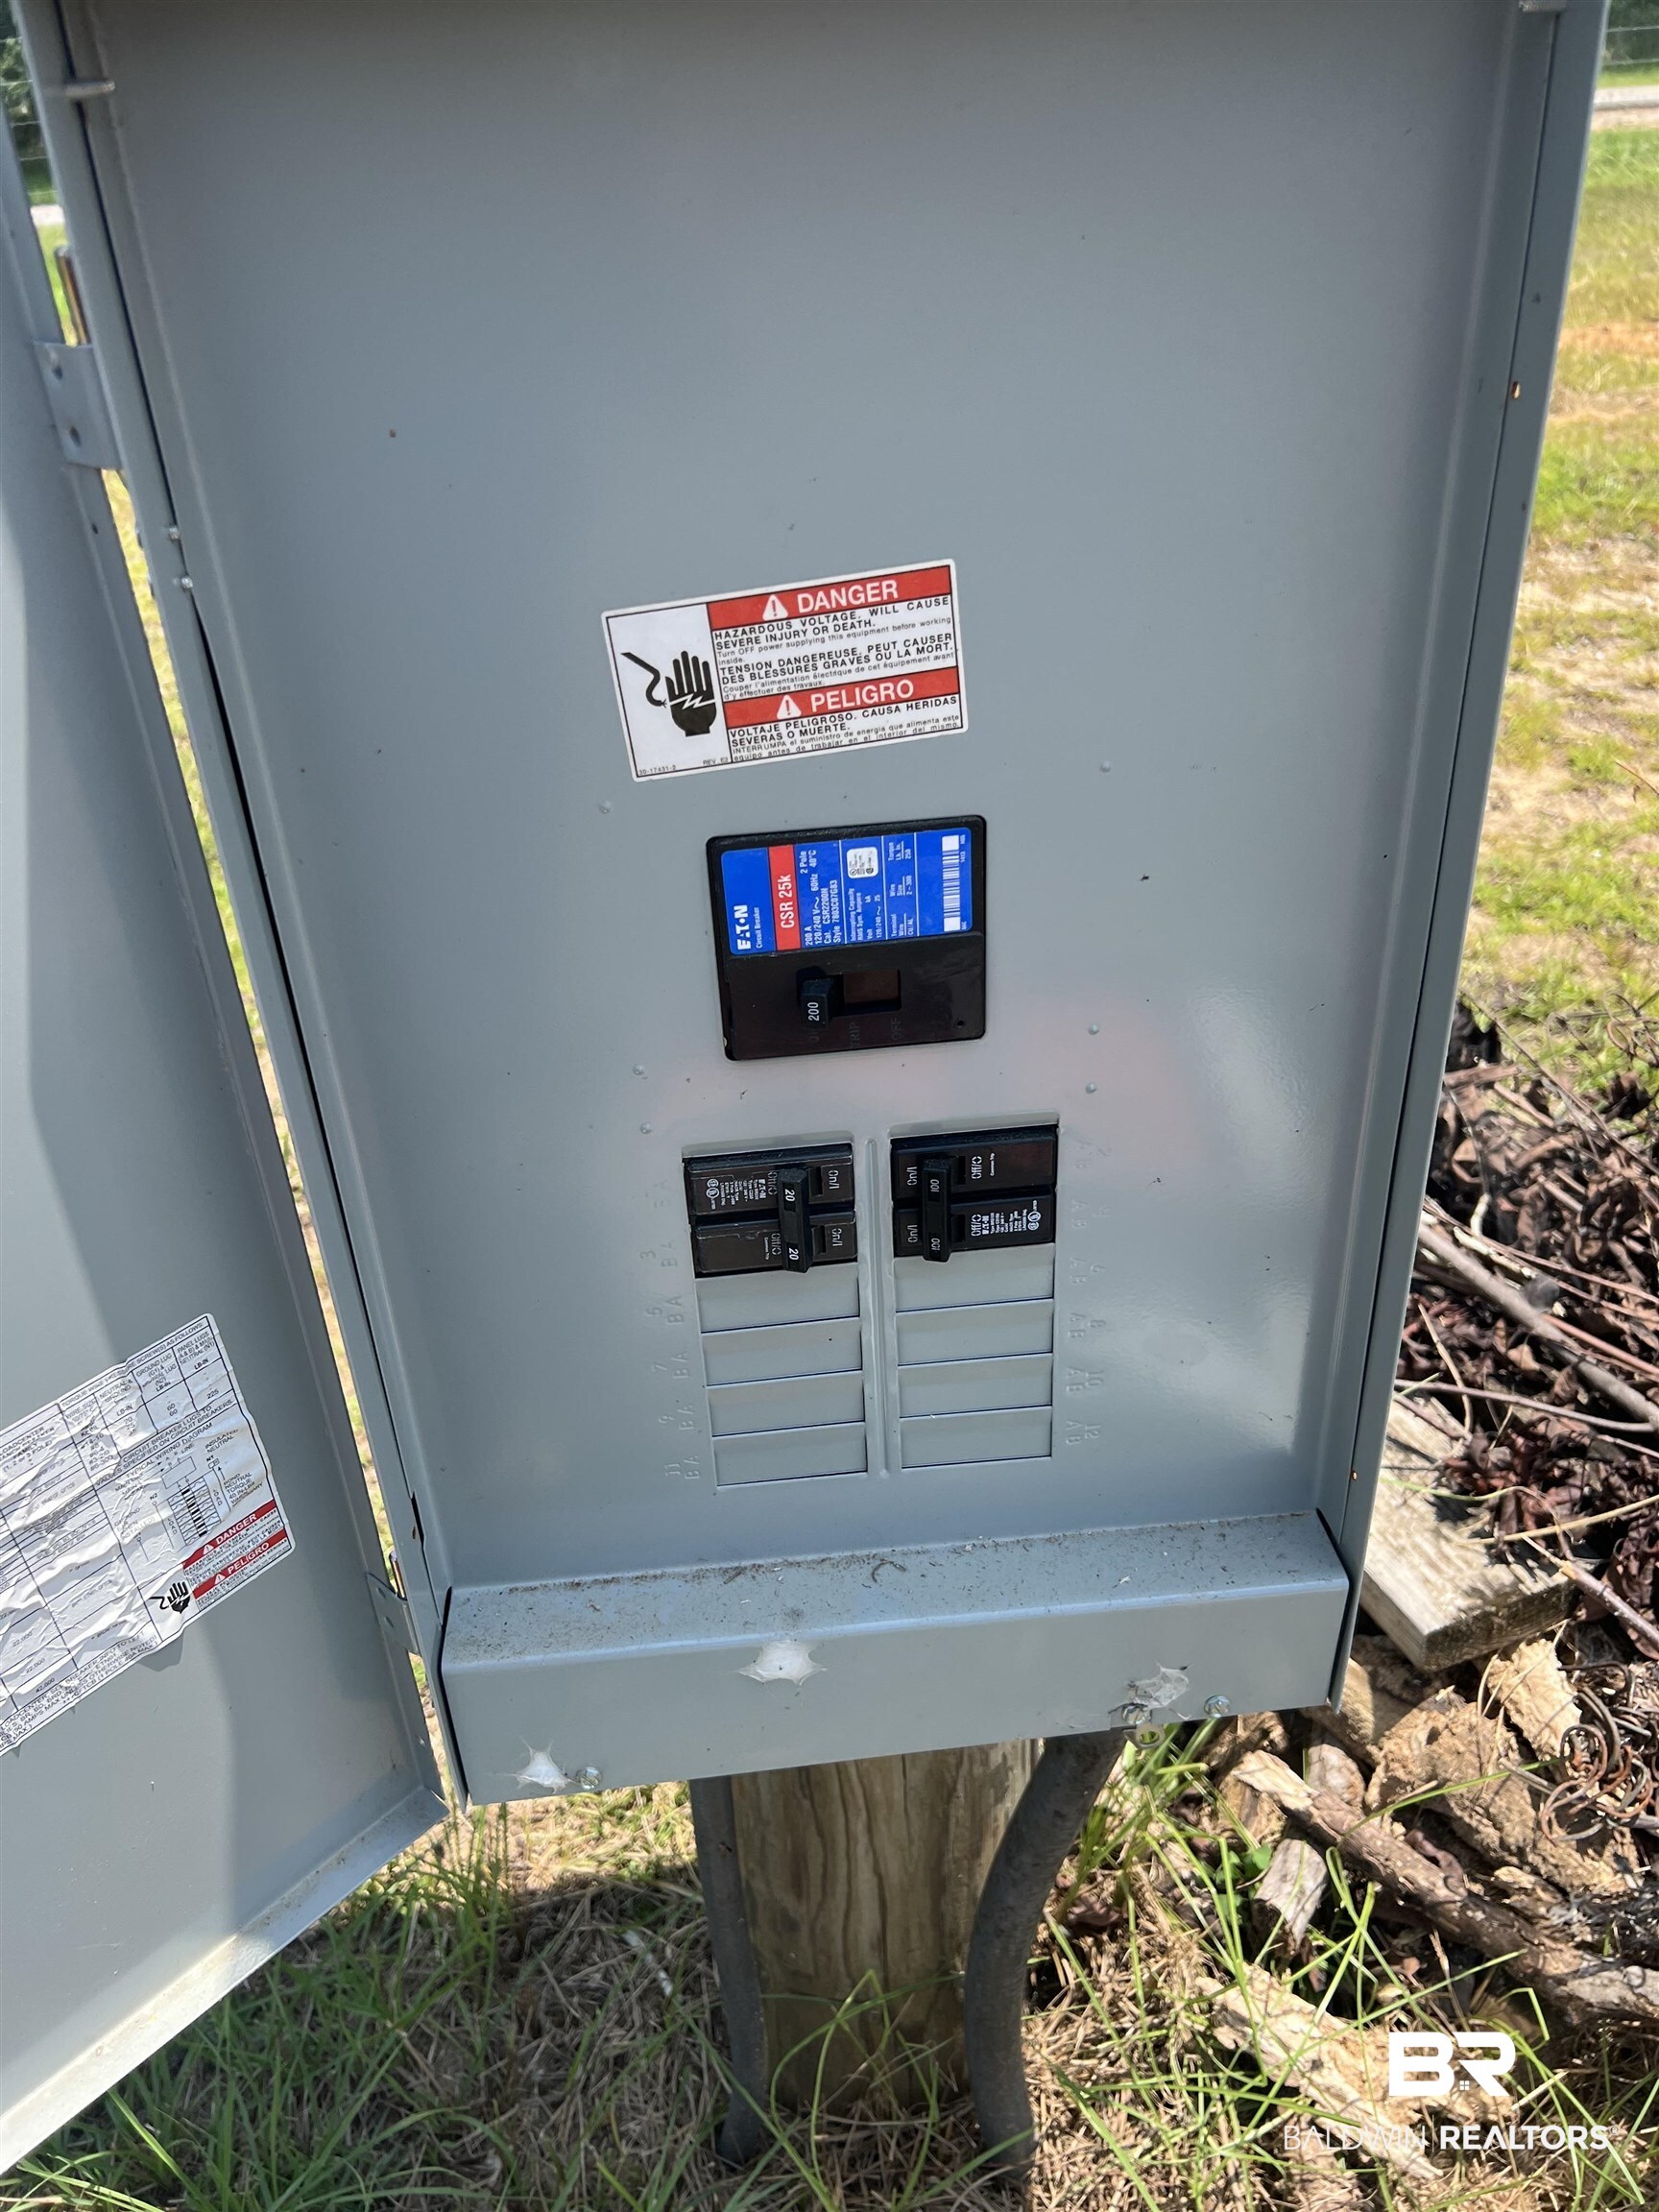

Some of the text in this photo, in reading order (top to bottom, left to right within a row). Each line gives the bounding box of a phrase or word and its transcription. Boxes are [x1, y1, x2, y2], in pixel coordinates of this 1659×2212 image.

[797, 578, 898, 613] DANGER
[714, 596, 949, 639] HAZARDOUS VOLTAGE. WILL CAUSE
[715, 618, 876, 650] SEVERE INJURY OR DEATH.
[717, 616, 950, 658] Turn OFF power supplying this equipment before working
[718, 656, 745, 665] inside.
[720, 633, 951, 676] TENSION DANGEREUSE. PEUT CAUSER
[721, 641, 952, 685] DES BLESSURES GRAVES OU LA MORT.
[723, 683, 752, 693] Couper
[932, 652, 953, 661] avant
[739, 686, 774, 697] effectuer
[809, 678, 914, 712] PELIGRO
[730, 696, 956, 738] VOLTAJE PELIGROSO. CAUSA HERIDAS
[731, 722, 850, 747] SEVERAS O MUERTE.
[733, 740, 786, 754] INTERRUMPA
[800, 732, 840, 744] suministro
[888, 723, 902, 732] que
[905, 717, 939, 728] alimenta
[733, 752, 762, 761] equipo
[767, 747, 790, 757] antes
[811, 739, 843, 750] trabajar
[876, 730, 906, 740] interior
[799, 851, 807, 867] Pole
[808, 849, 817, 867] 40°C
[809, 873, 818, 891] 60Hz
[777, 874, 794, 928] CSR 25k
[847, 887, 855, 910] Capacity
[812, 915, 822, 944] 120/240
[832, 925, 841, 943] Style
[807, 1001, 820, 1022] 200
[784, 1189, 795, 1202] 20
[930, 1179, 940, 1192] 100
[789, 1247, 799, 1261] 20
[931, 1238, 940, 1251] 100
[121, 1405, 212, 1463] CIRCUIT BREAKER LUGS TO
[121, 1398, 233, 1470] SPECIFIED ON CIRCUIT BREAKERS
[125, 1421, 214, 1479] TYPICAL WIRING DIAGRAM
[215, 1511, 257, 1549] DANGER
[228, 1541, 270, 1575] PELIGRO
